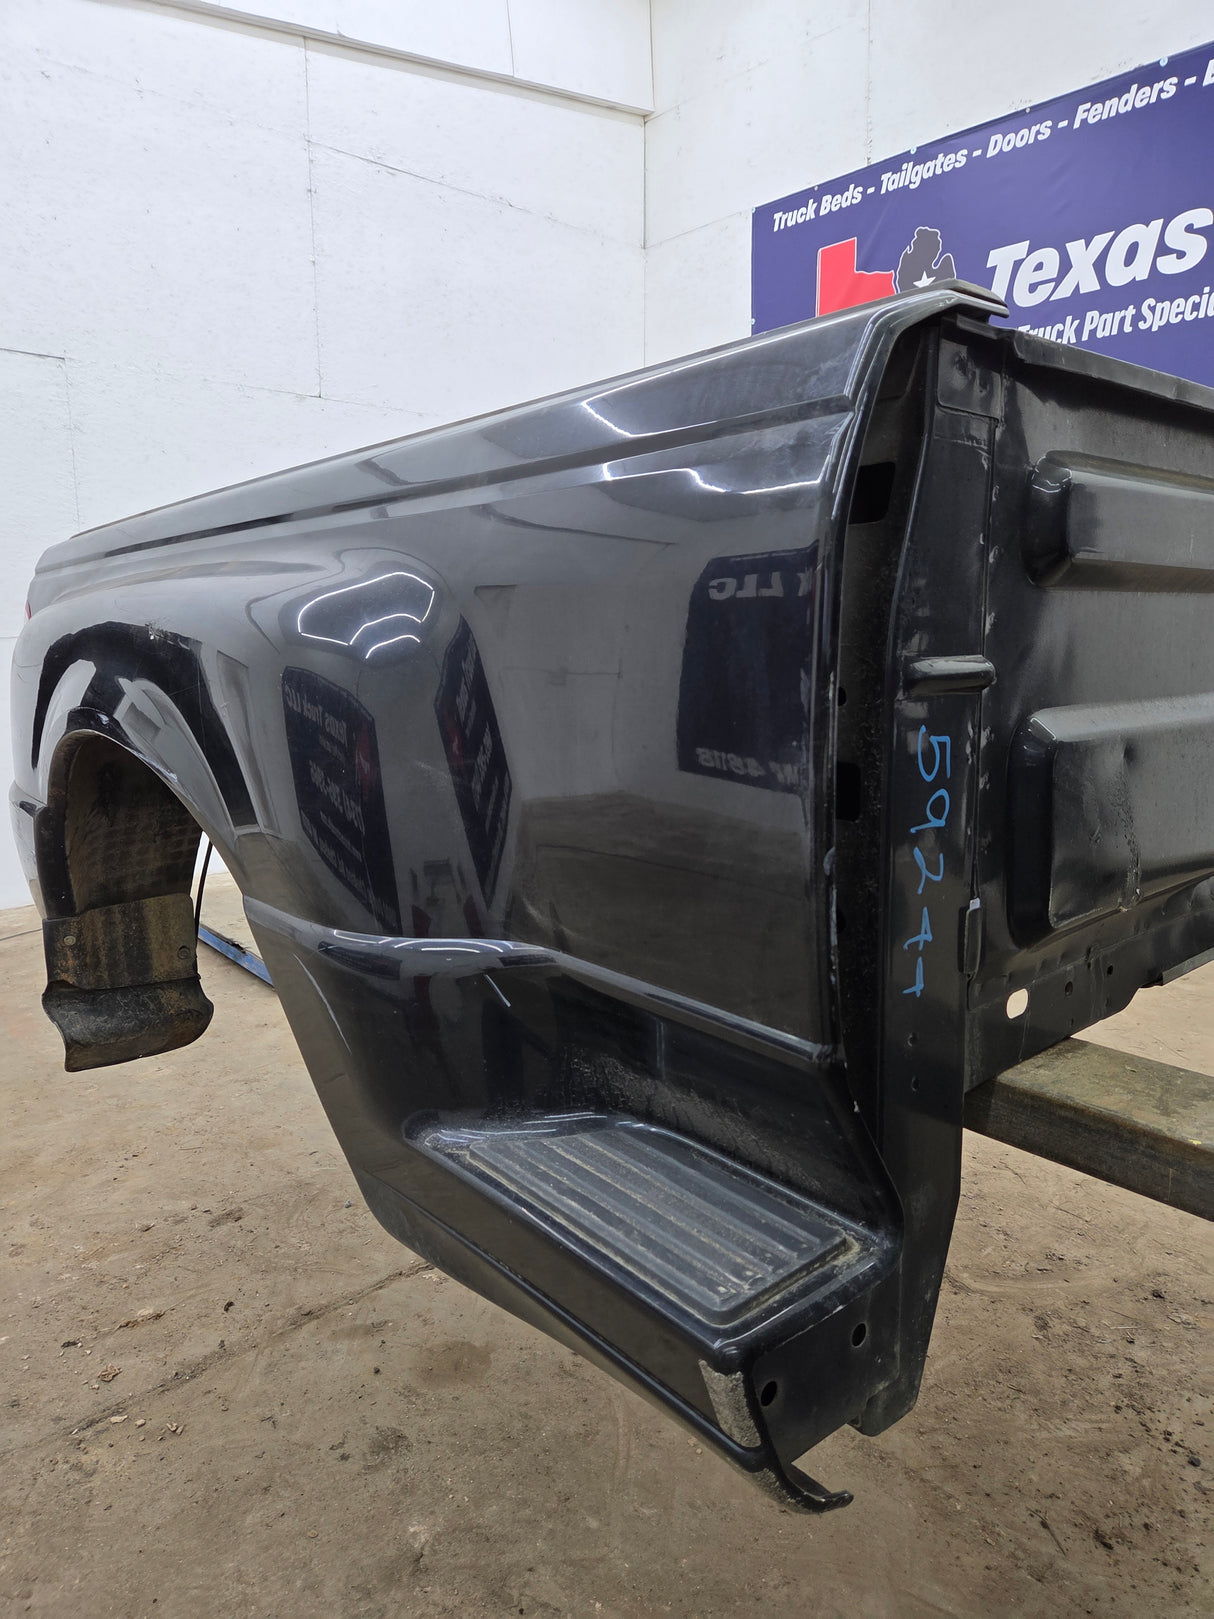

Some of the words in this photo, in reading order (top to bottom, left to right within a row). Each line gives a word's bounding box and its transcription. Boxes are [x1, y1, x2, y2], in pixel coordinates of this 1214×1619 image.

[773, 199, 817, 232] Truck
[819, 184, 863, 217] Beds
[880, 149, 968, 194] Tailgates
[986, 119, 1052, 158] Doors
[1072, 76, 1178, 130] Fenders
[985, 207, 1214, 308] Texas
[1081, 304, 1136, 342] Part
